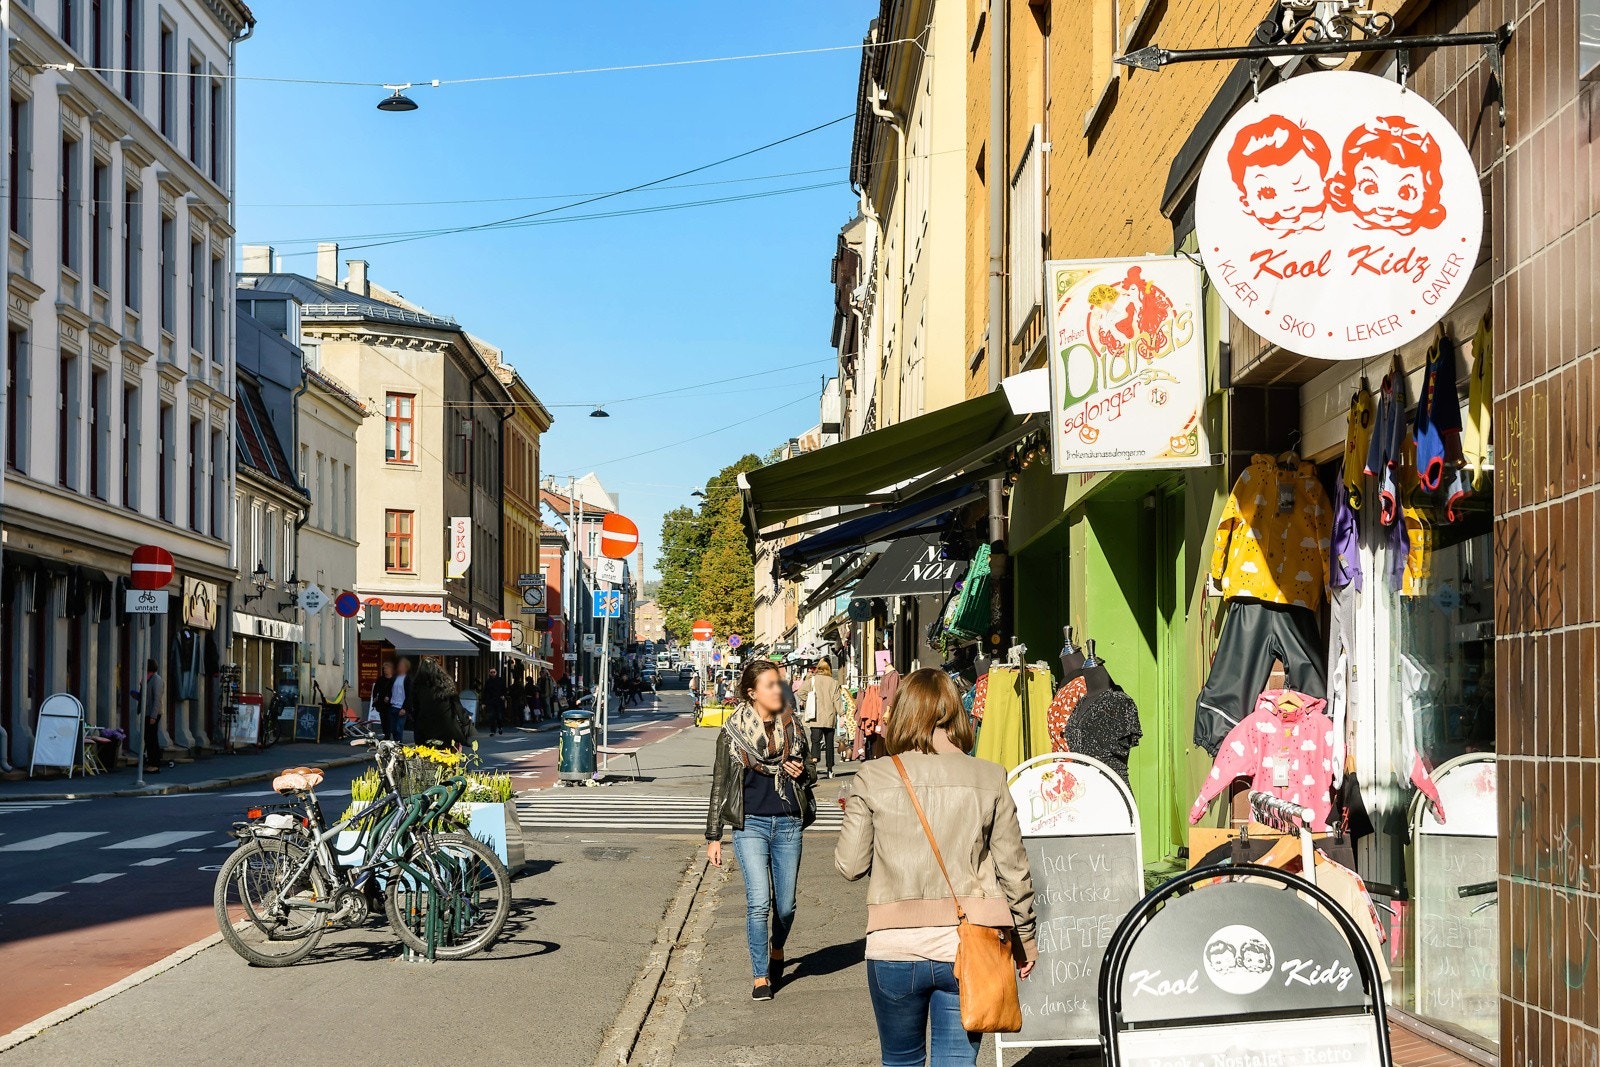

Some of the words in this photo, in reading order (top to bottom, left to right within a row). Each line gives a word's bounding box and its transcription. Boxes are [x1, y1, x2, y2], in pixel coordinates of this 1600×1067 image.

[1250, 249, 1332, 280] Kool
[1347, 244, 1431, 284] Kidz
[1421, 252, 1465, 306] GAVER
[1217, 259, 1259, 308] KLÆR
[1279, 314, 1316, 339] SKO
[1346, 314, 1403, 342] LEKER
[1064, 381, 1142, 434] salonger
[456, 520, 466, 563] SKO
[900, 562, 956, 582] NOA
[1041, 845, 1078, 876] har
[1089, 844, 1111, 872] vi
[1033, 883, 1120, 905] ntastiske
[1037, 913, 1126, 953] ATTE
[1051, 955, 1092, 987] 100%
[1128, 969, 1199, 998] Kool
[1280, 958, 1353, 993] Kidz
[1040, 995, 1090, 1016] danske
[1211, 1050, 1285, 1067] Nostalgi
[1301, 1046, 1352, 1064] Retro
